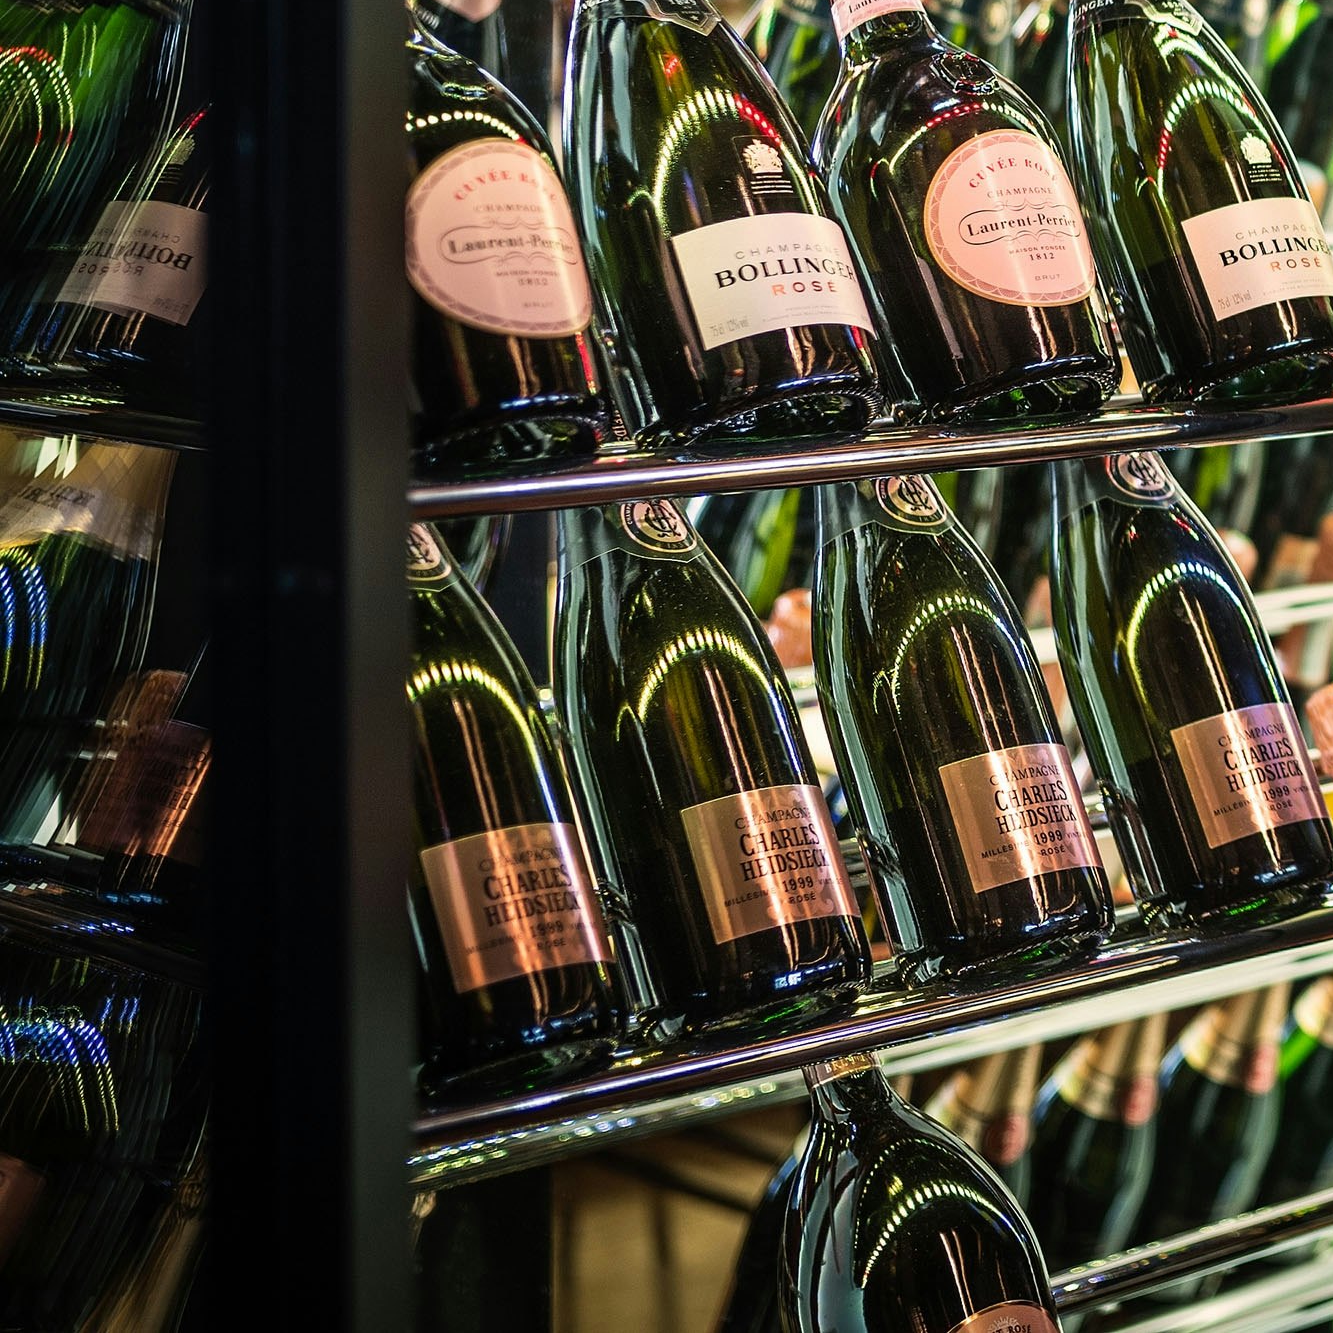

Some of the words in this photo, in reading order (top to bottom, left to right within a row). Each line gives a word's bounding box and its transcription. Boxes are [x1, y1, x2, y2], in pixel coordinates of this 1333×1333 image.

[968, 157, 1017, 188] CUVÉE
[986, 186, 1053, 199] CHAMPAGNE
[966, 212, 1077, 237] Laurent-Perrier
[1235, 224, 1308, 241] CHAMPAG
[734, 242, 841, 260] CHAMPAGNE
[1029, 252, 1055, 261] 1812
[714, 257, 856, 289] BOLLINGER
[1269, 256, 1322, 273] ROSÉ
[771, 280, 838, 298] ROSÉ
[1217, 721, 1290, 748] CMPAGNE
[989, 765, 1062, 787] CAMPAGNE
[994, 780, 1068, 812] CHARLES
[1264, 784, 1291, 801] 1999
[995, 804, 1078, 835] HEIDSIECK
[739, 822, 821, 857] CHARLES
[1034, 829, 1063, 846] 1999
[1041, 845, 1066, 857] ROSÉ
[740, 848, 830, 882] HEIDSIECK
[483, 863, 572, 902] CHARLES
[782, 875, 815, 893] 1999
[788, 891, 817, 905] ROSÉ
